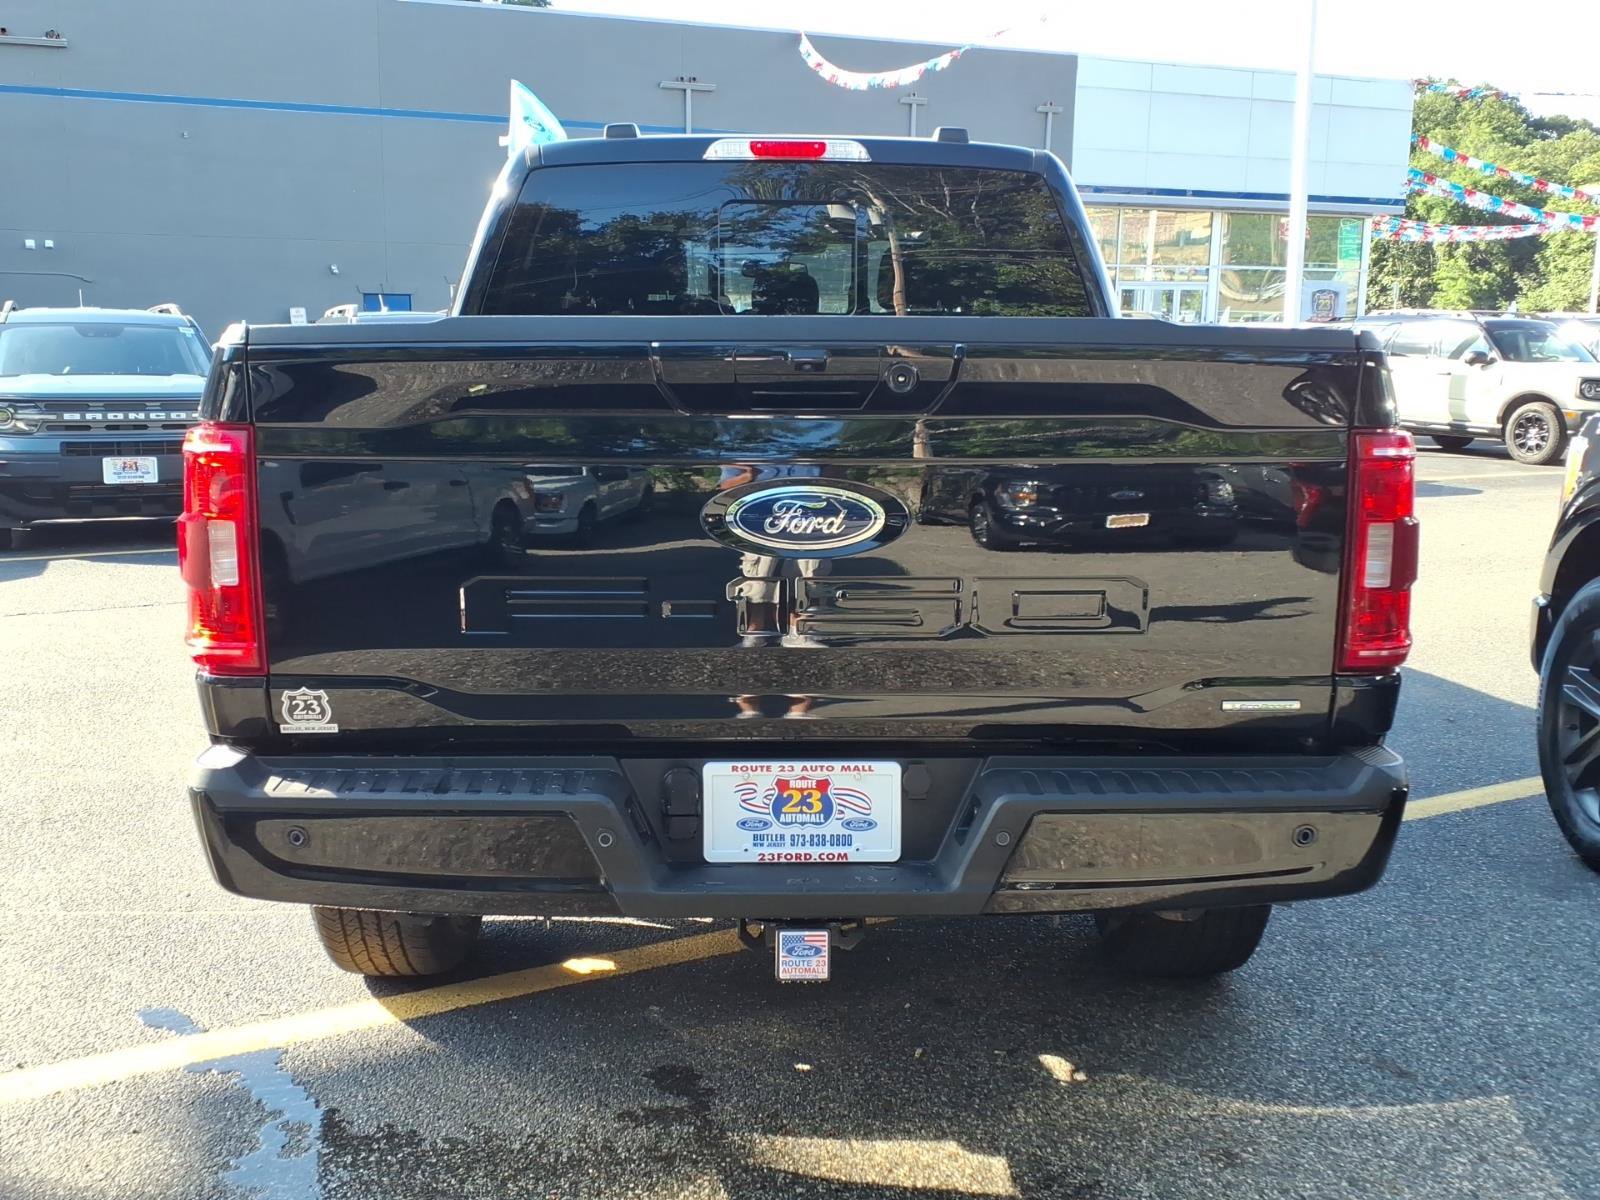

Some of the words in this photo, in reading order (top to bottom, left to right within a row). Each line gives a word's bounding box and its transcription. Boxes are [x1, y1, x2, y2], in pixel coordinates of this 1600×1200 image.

[63, 412, 187, 420] BRONCO
[763, 499, 846, 535] Ford
[458, 575, 1150, 637] F-150
[291, 700, 321, 715] 23
[731, 764, 772, 773] ROUTE
[778, 764, 795, 773] 23
[800, 764, 835, 773] AUTO
[840, 764, 875, 773] MALL
[789, 779, 817, 789] ROUTE
[781, 789, 822, 814] 23
[779, 813, 825, 823] AUTOMALL
[744, 819, 765, 829] Ford
[848, 819, 870, 829] Ford
[752, 833, 786, 842] BUTLER
[789, 833, 853, 847] 973-838-0800
[758, 852, 849, 861] 23FORD.COM
[791, 945, 816, 956] Ford
